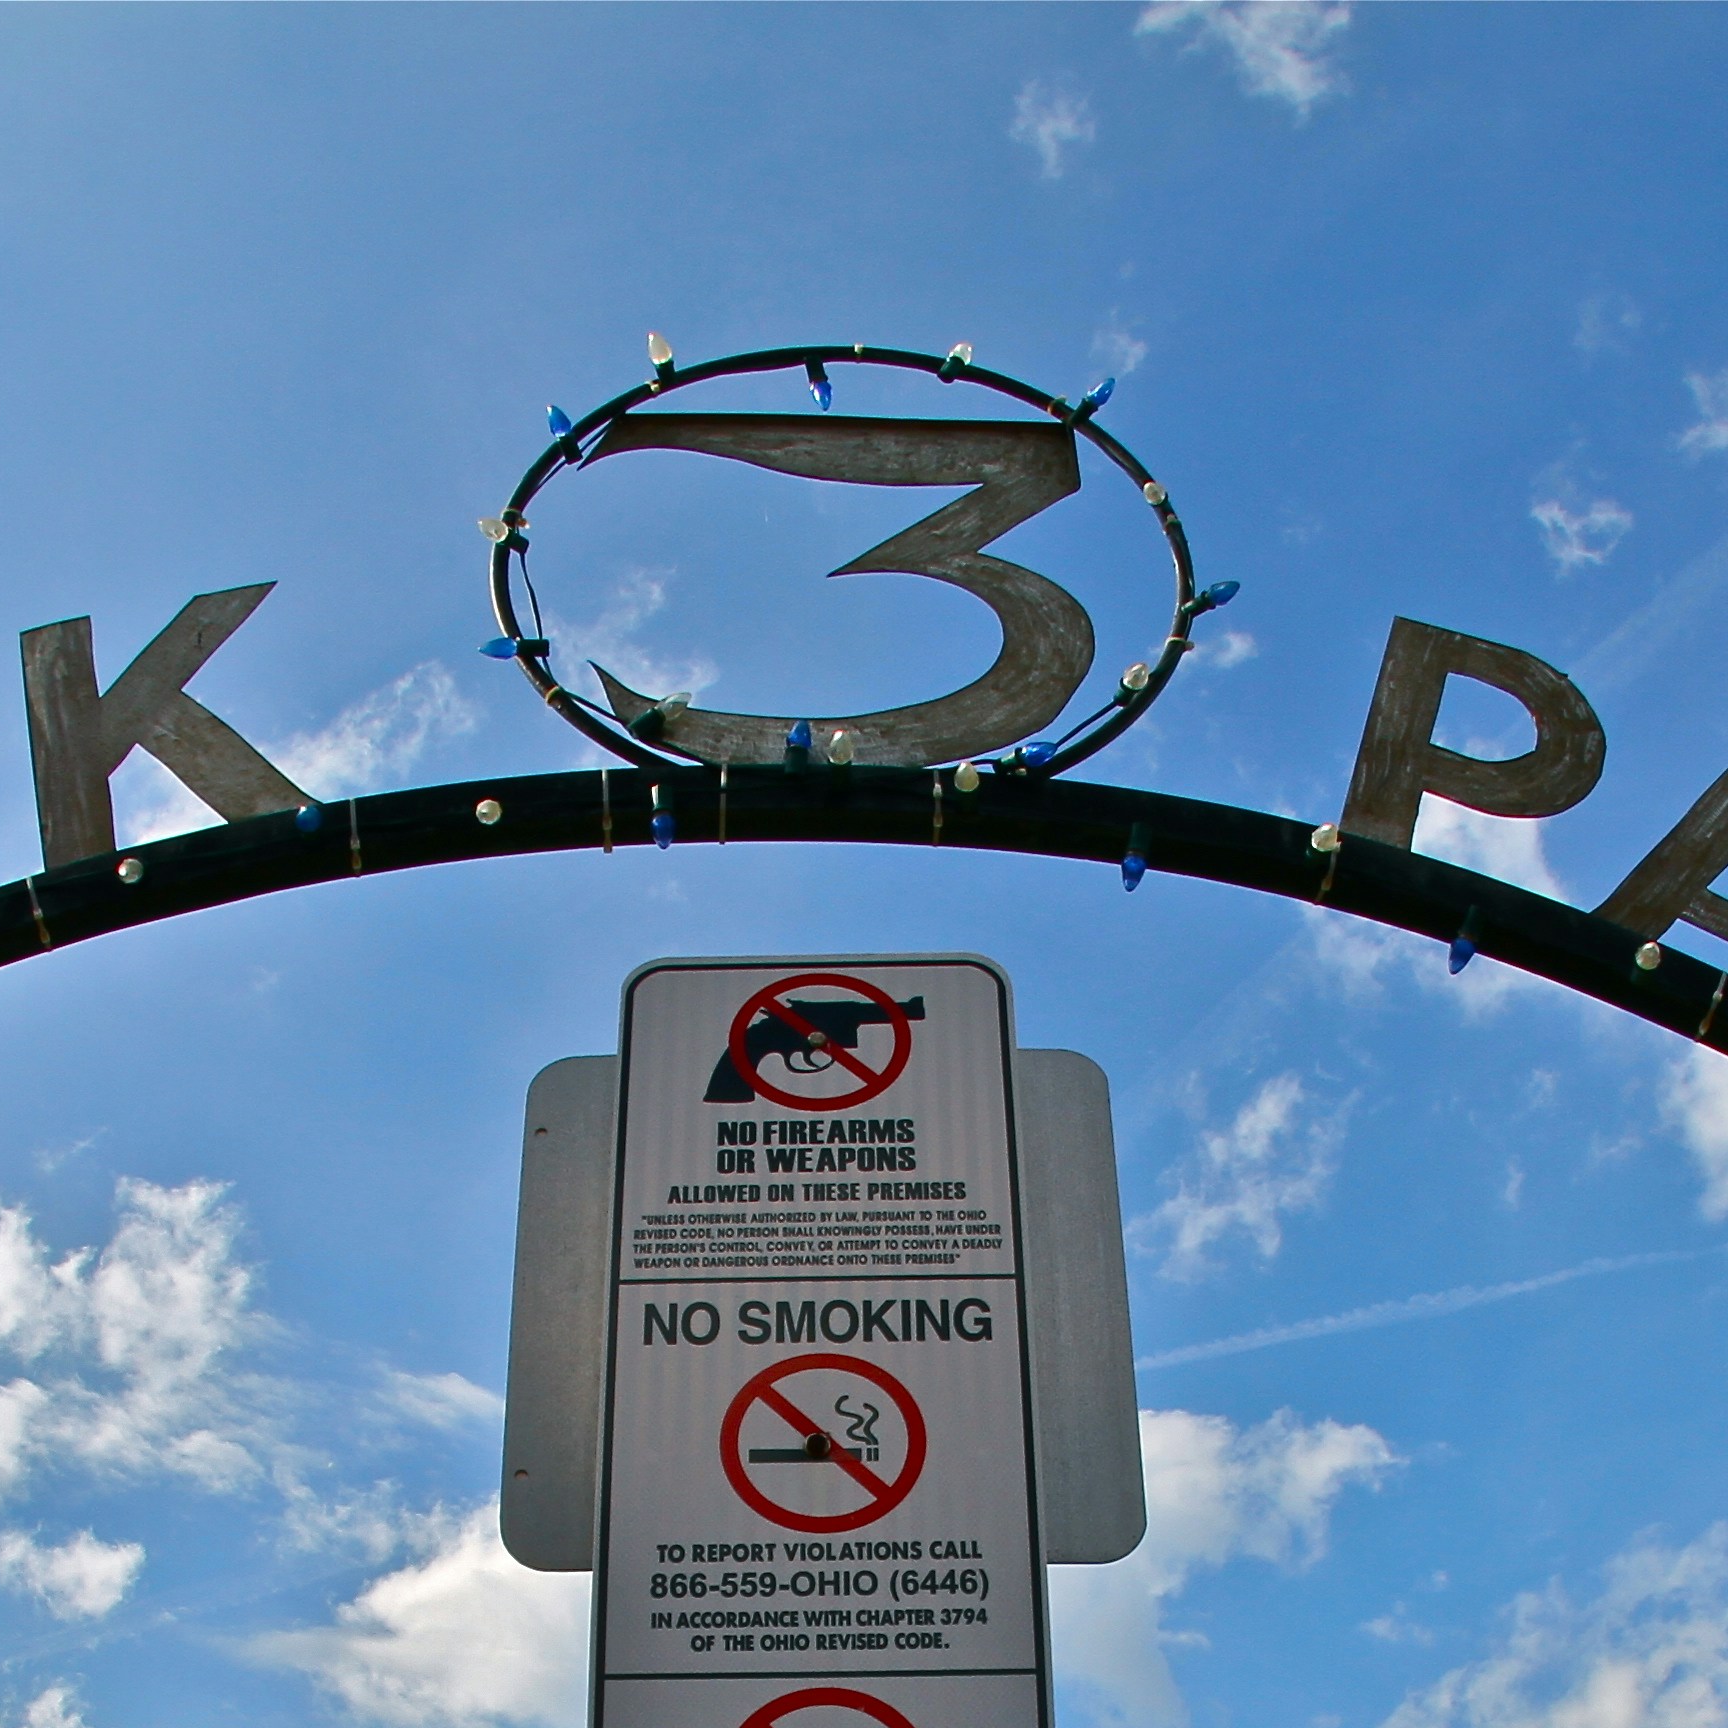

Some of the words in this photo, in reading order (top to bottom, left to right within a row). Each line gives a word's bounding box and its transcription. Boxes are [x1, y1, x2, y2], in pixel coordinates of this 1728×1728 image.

[581, 413, 1093, 767] 3
[718, 1121, 756, 1146] NO
[762, 1119, 915, 1145] FIREARMS
[717, 1150, 755, 1174] OR
[766, 1147, 916, 1173] WEAPONS
[668, 1185, 760, 1204] ALLOWED
[768, 1184, 794, 1202] ON
[802, 1183, 860, 1201] THESE
[868, 1182, 966, 1200] PREMISES
[688, 1213, 746, 1224] OTHERWISE
[750, 1212, 816, 1223] AUTHORIZED
[820, 1212, 833, 1222] BY
[835, 1212, 859, 1222] LAW,
[862, 1211, 915, 1221] PURSUANT
[919, 1211, 932, 1221] TO
[936, 1210, 954, 1220] THE
[957, 1210, 986, 1220] OHIO
[633, 1229, 676, 1240] REVISED
[680, 1228, 715, 1239] CODE,
[717, 1228, 734, 1238] NO
[737, 1227, 778, 1238] PERSON
[782, 1227, 813, 1237] SHALL
[817, 1225, 881, 1236] KNOWINGLY
[936, 1225, 963, 1235] HAVE
[965, 1224, 1001, 1234] UNDER
[633, 1243, 653, 1254] THE
[655, 1242, 705, 1253] PERSON'S
[818, 1241, 833, 1251] OR
[837, 1240, 881, 1250] ATTEMPT
[885, 1240, 898, 1250] TO
[902, 1239, 947, 1249] CONVEY
[952, 1239, 960, 1249] A
[962, 1238, 1002, 1249] DEADLY
[633, 1258, 680, 1268] WEAPON
[684, 1257, 701, 1267] OR
[702, 1256, 768, 1267] DANGEROUS
[772, 1255, 834, 1265] ORDNANCE
[837, 1255, 867, 1265] ONTO
[872, 1254, 901, 1264] THESE
[643, 1302, 721, 1346] NO
[738, 1298, 993, 1344] SMOKING
[657, 1545, 685, 1563] TO
[692, 1544, 776, 1563] REPORT
[783, 1541, 923, 1561] VIOLATIONS
[929, 1540, 982, 1559] CALL
[650, 1570, 878, 1599] 866-559-OHIO
[890, 1568, 989, 1602] (6446)
[651, 1613, 672, 1628] IN
[676, 1611, 798, 1628] ACCORDANCE
[803, 1610, 850, 1626] WITH
[856, 1609, 936, 1626] CHAPTER
[941, 1608, 987, 1625] 3794
[691, 1635, 716, 1652] OF
[722, 1634, 755, 1651] THE
[760, 1634, 809, 1651] OHIO
[816, 1633, 888, 1650] REVISED
[894, 1632, 950, 1649] CODE.
